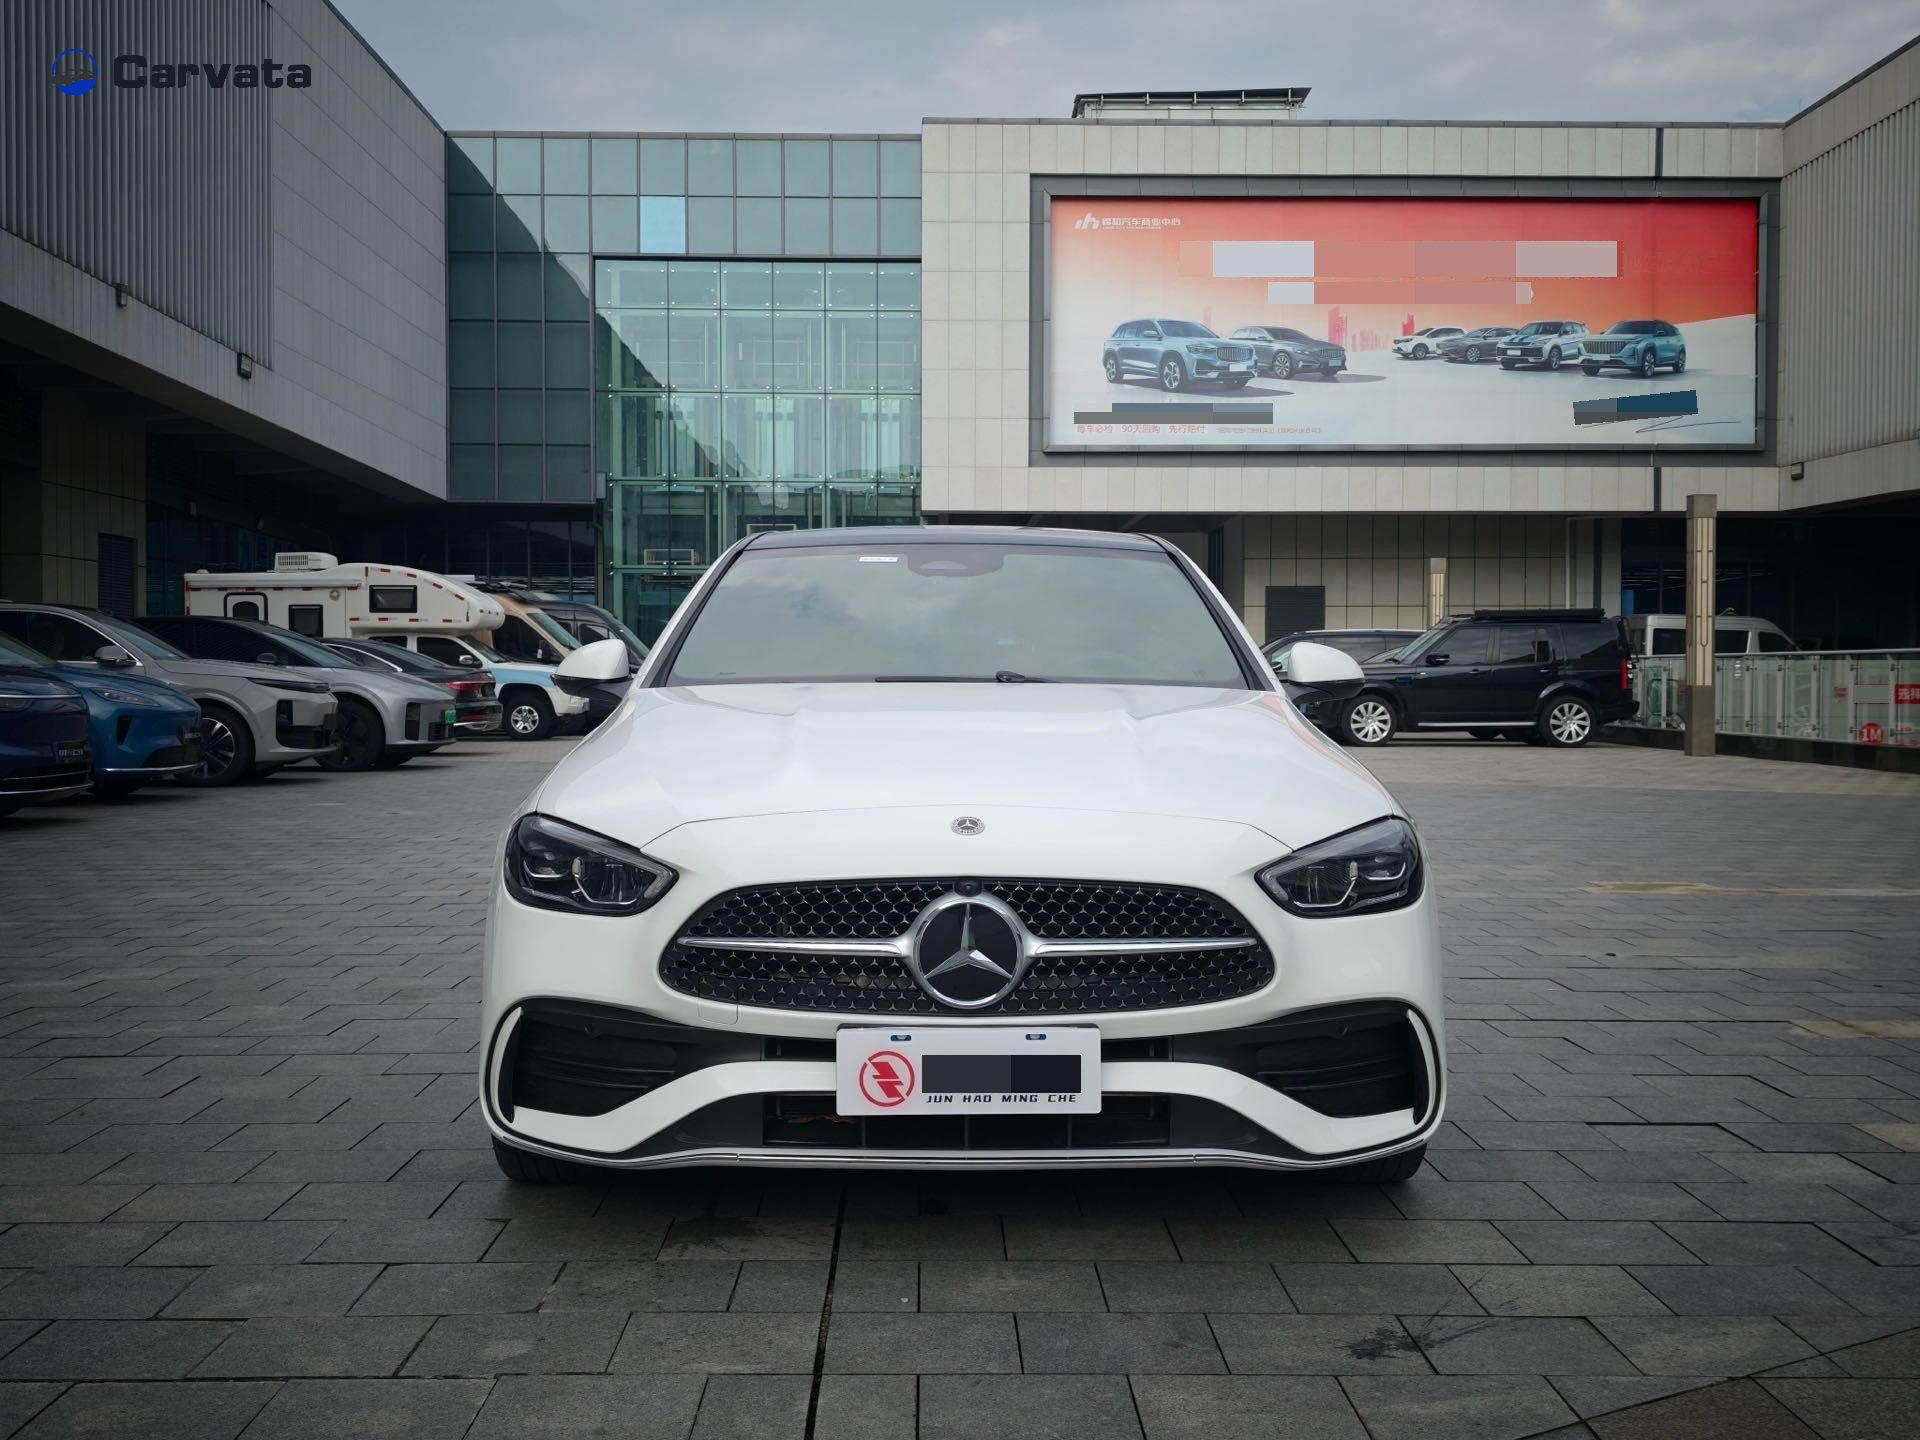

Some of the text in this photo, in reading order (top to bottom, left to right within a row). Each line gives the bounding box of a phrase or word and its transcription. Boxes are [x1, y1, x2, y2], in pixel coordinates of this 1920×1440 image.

[925, 1093, 1077, 1104] JUN HAO MING CHE
